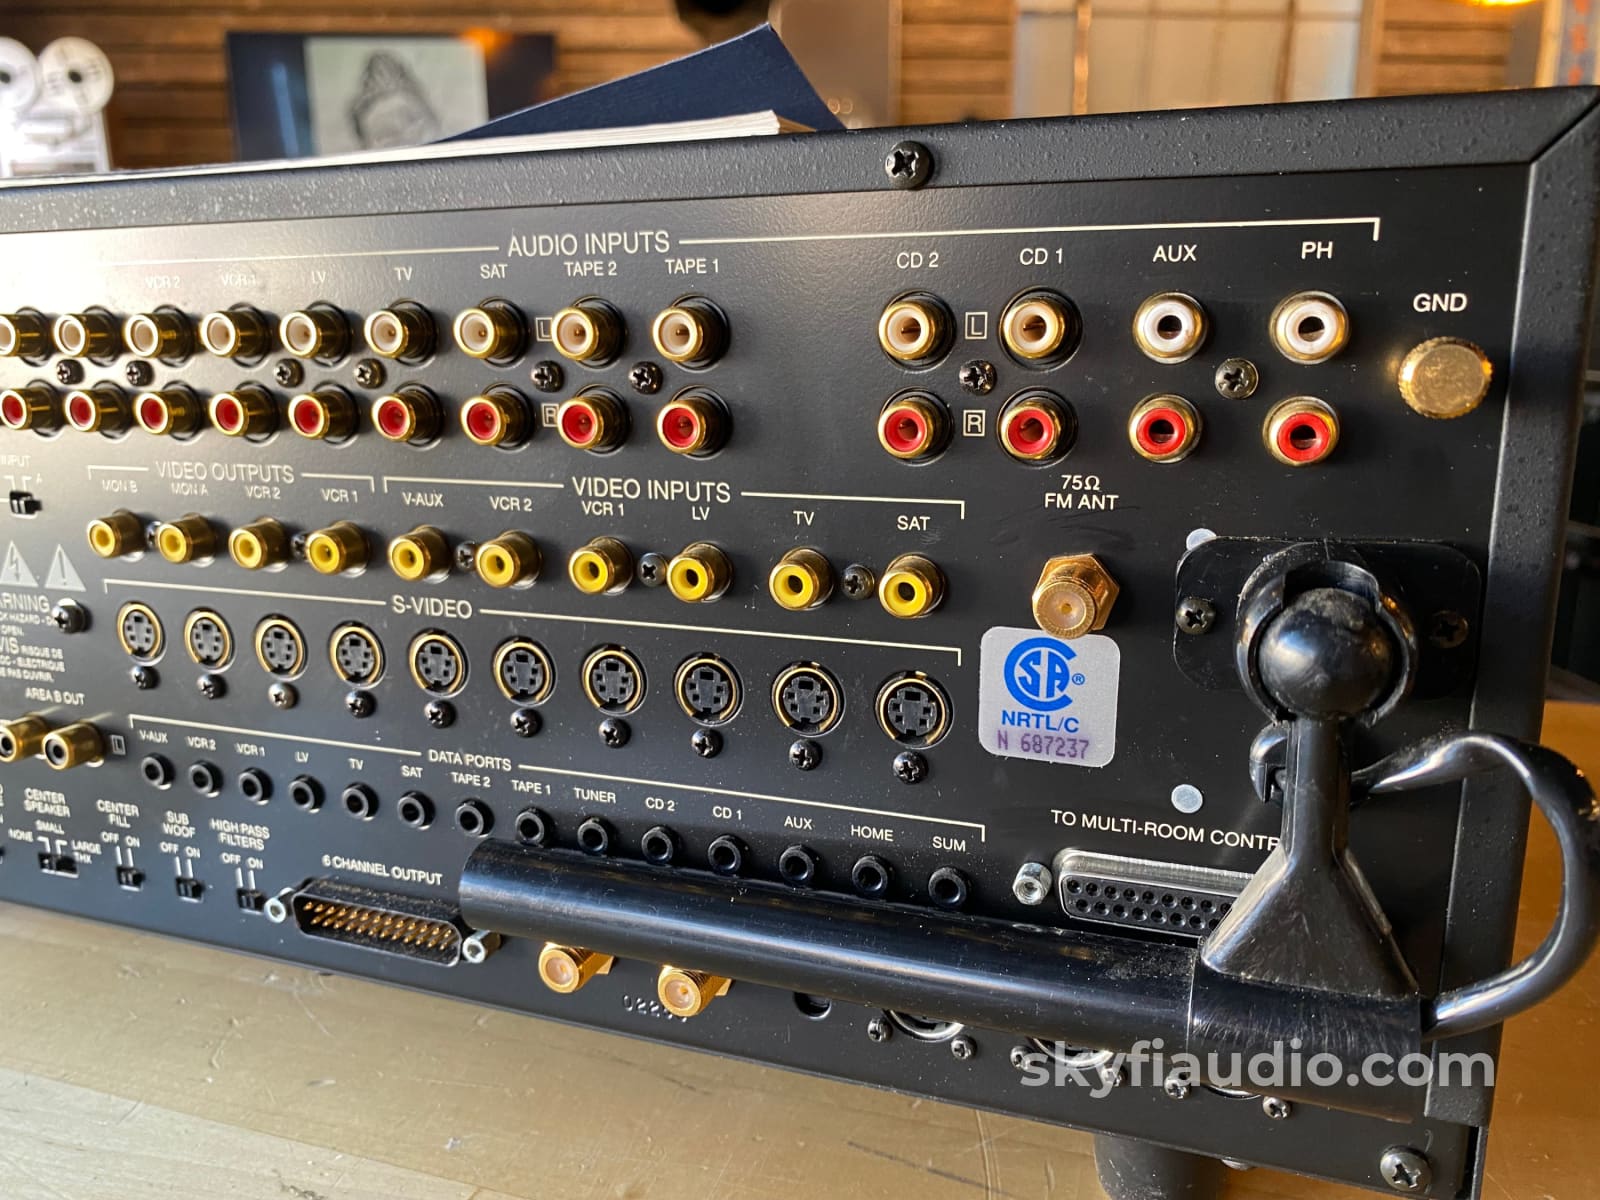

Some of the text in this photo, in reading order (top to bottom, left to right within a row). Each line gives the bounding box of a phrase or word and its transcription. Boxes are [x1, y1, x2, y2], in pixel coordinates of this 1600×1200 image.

[508, 230, 671, 257] AUDIO INPUTS
[1301, 241, 1333, 259] PH
[896, 252, 939, 269] CD 2
[1019, 248, 1063, 265] CD 1
[1152, 244, 1198, 262] AUX
[394, 266, 412, 281] TV
[480, 264, 508, 279] SAT
[564, 261, 617, 277] TAPE 2
[665, 258, 719, 275] TAPE 1
[311, 271, 326, 284] LV
[1413, 293, 1468, 313] GND
[971, 316, 983, 336] L
[967, 414, 982, 433] R
[155, 461, 295, 484] VIDEO OUTPUTS
[102, 480, 128, 493] MON
[172, 483, 201, 496] MON
[572, 476, 731, 504] VIDEO INPUTS
[1061, 475, 1101, 491] 75Ω
[245, 486, 281, 500] VCR 2
[321, 488, 359, 503] VCR 1
[402, 492, 444, 508] V-AUX
[489, 496, 533, 512] VCR 2
[582, 501, 624, 517] VCR 1
[1044, 493, 1119, 511] FM ANT
[692, 505, 710, 522] LV
[794, 510, 815, 527] TV
[897, 514, 931, 532] SAT
[392, 595, 473, 619] S-VIDEO
[25, 687, 85, 706] AREA B OUT
[1002, 709, 1080, 733] NRTL/C
[140, 730, 168, 744] V-AUX
[187, 736, 216, 750] VCR 2
[997, 730, 1089, 760] N 687237
[236, 743, 266, 757] VCR 1
[296, 751, 309, 764] LV
[350, 758, 364, 772] TV
[428, 750, 512, 772] DATA PORTS
[401, 765, 424, 779] SAT
[451, 771, 491, 788] TAPE 2
[24, 787, 66, 806] CENTER
[511, 780, 551, 796] TAPE 1
[574, 787, 616, 804] TUNER
[24, 800, 70, 818] SPEAKER
[96, 799, 139, 818] CENTER
[645, 797, 675, 813] CD 2
[712, 805, 742, 821] CD 1
[109, 813, 131, 829] FILL
[166, 810, 189, 826] SUB
[784, 816, 813, 831] AUX
[8, 829, 34, 843] NONE
[36, 820, 65, 835] SMALL
[162, 821, 196, 839] WOOF
[209, 818, 271, 840] HIGH PASS
[851, 824, 894, 842] HOME
[1050, 809, 1282, 851] TO MULTI-ROOM CONTR
[71, 840, 102, 855] LARGE
[101, 831, 140, 849] OFF ON
[219, 832, 265, 851] FILTERS
[932, 836, 966, 852] SUM
[160, 841, 201, 859] OFF ON
[221, 851, 264, 870] OFF ON
[322, 854, 443, 886] 6 CHANNEL OUTPUT
